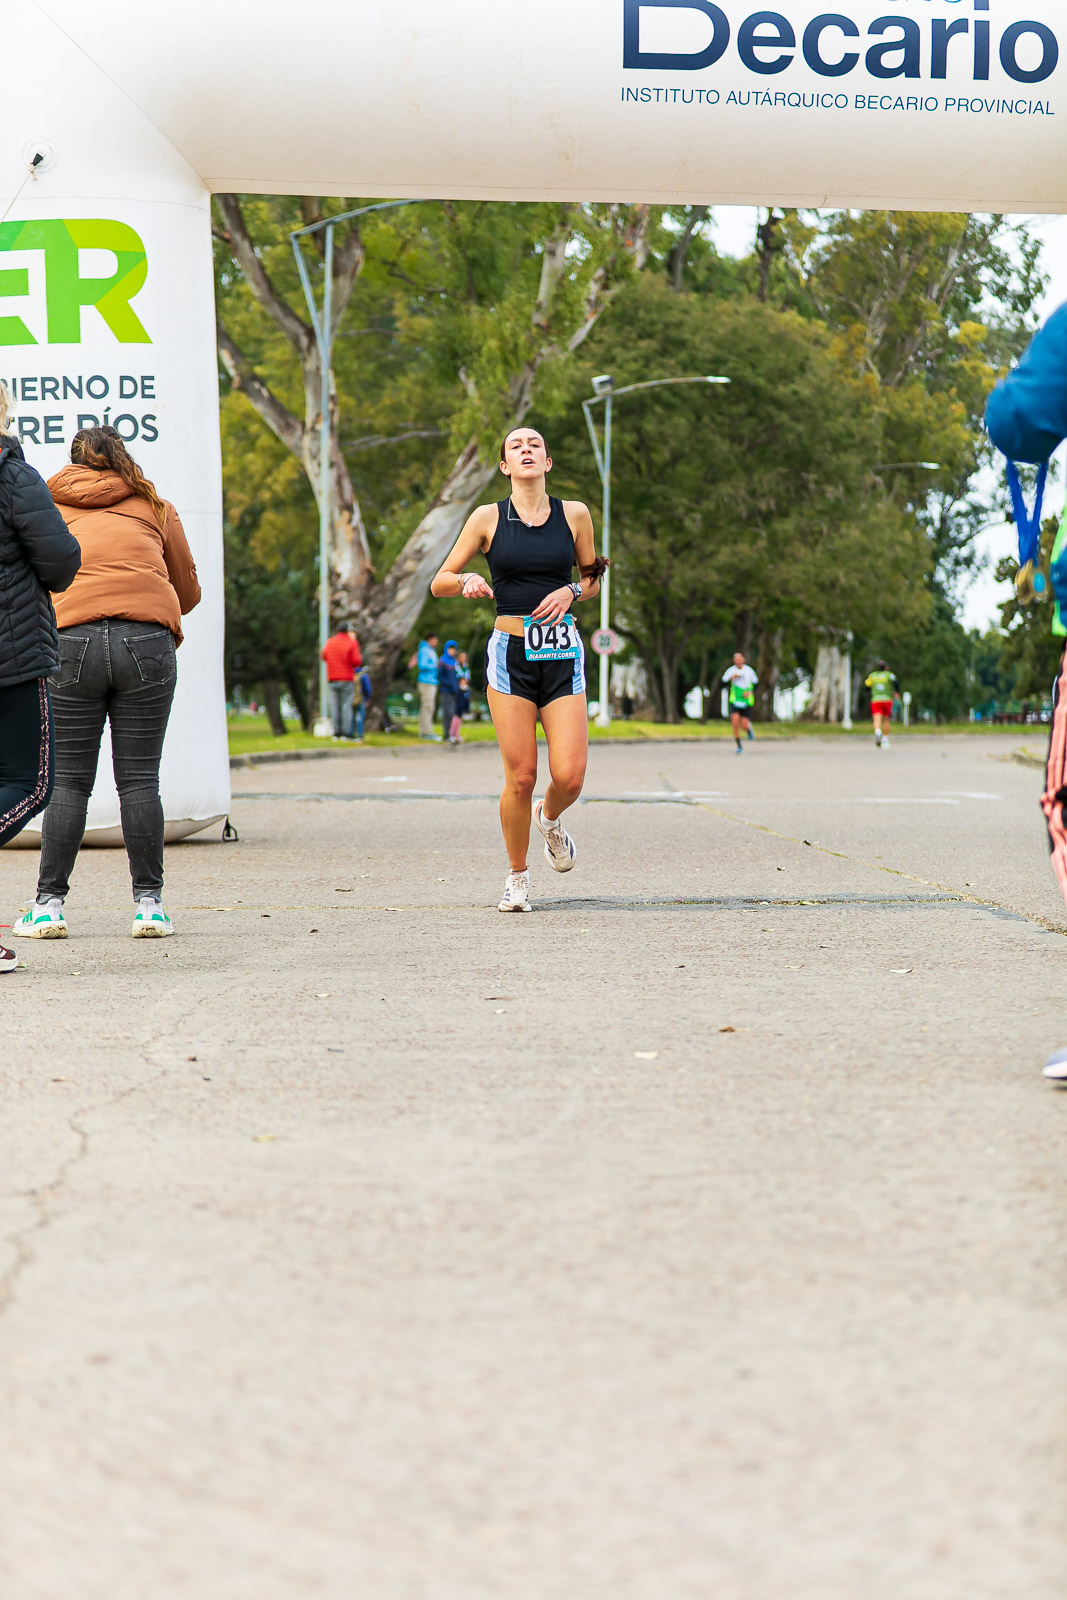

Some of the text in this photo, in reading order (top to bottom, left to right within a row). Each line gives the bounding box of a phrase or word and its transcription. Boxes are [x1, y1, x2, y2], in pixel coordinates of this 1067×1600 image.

[621, 87, 1056, 115] INSTITUTO AUTÁRQUICO BECARIO PROVINCIAL
[0, 375, 156, 400] IERNO DE
[12, 414, 65, 445] RE
[528, 622, 571, 651] 043
[528, 652, 557, 660] DIAMANTE
